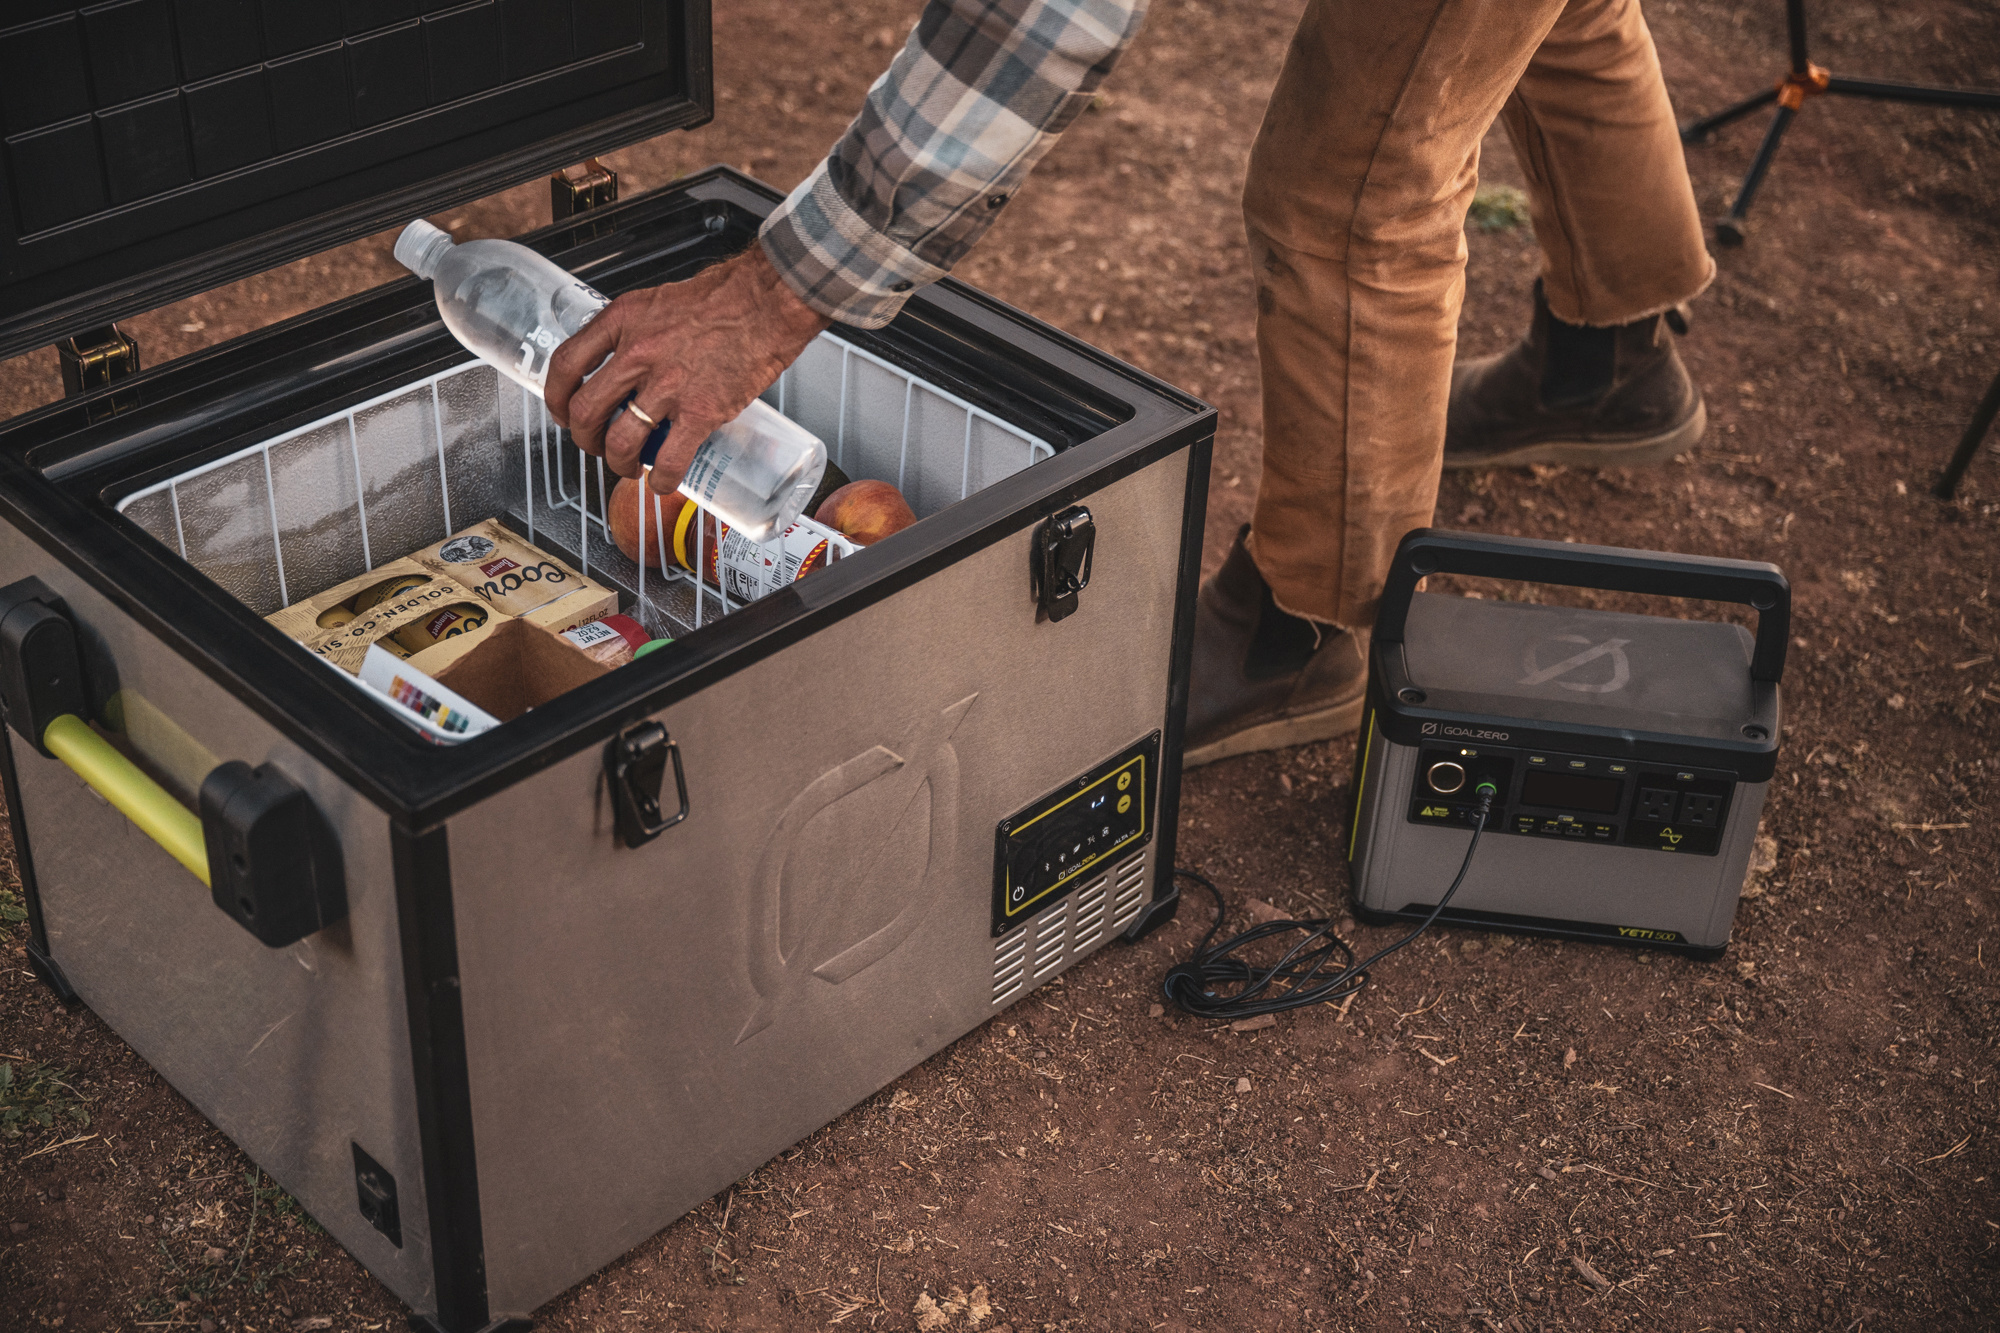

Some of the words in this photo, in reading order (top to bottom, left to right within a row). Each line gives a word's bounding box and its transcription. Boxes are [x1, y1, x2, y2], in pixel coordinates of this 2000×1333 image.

[526, 325, 560, 356] ter
[486, 558, 516, 577] Banquet
[474, 561, 572, 602] Coors
[376, 586, 454, 620] GOLDEN,
[345, 620, 377, 638] CO.
[431, 611, 457, 637] Banquet
[576, 630, 589, 638] OZ
[578, 634, 596, 644] WT.
[594, 629, 611, 639] NET
[315, 639, 343, 655] SIN
[1444, 726, 1509, 741] GOALZERO
[1113, 833, 1129, 846] ALTA
[1067, 852, 1097, 875] GOALZERO
[1618, 927, 1655, 939] YETI
[1655, 932, 1676, 942] 500
